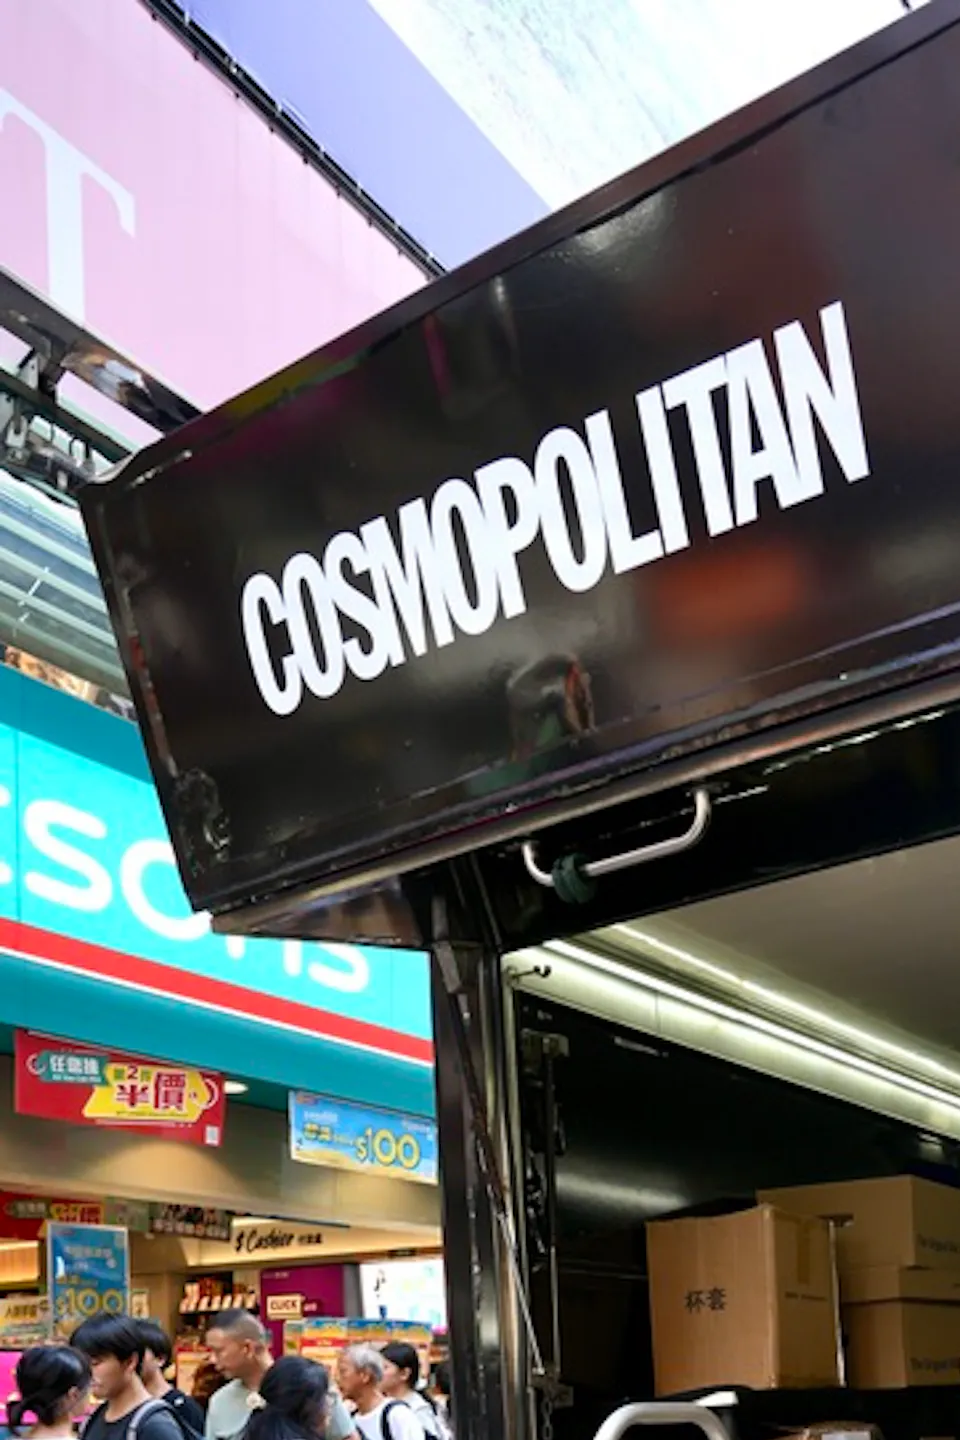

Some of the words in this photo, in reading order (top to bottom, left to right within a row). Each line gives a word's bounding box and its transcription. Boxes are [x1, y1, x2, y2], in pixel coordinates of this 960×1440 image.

[241, 299, 872, 716] COSMOPOLITAN
[354, 1127, 421, 1169] $100
[685, 1286, 727, 1314] 杯套
